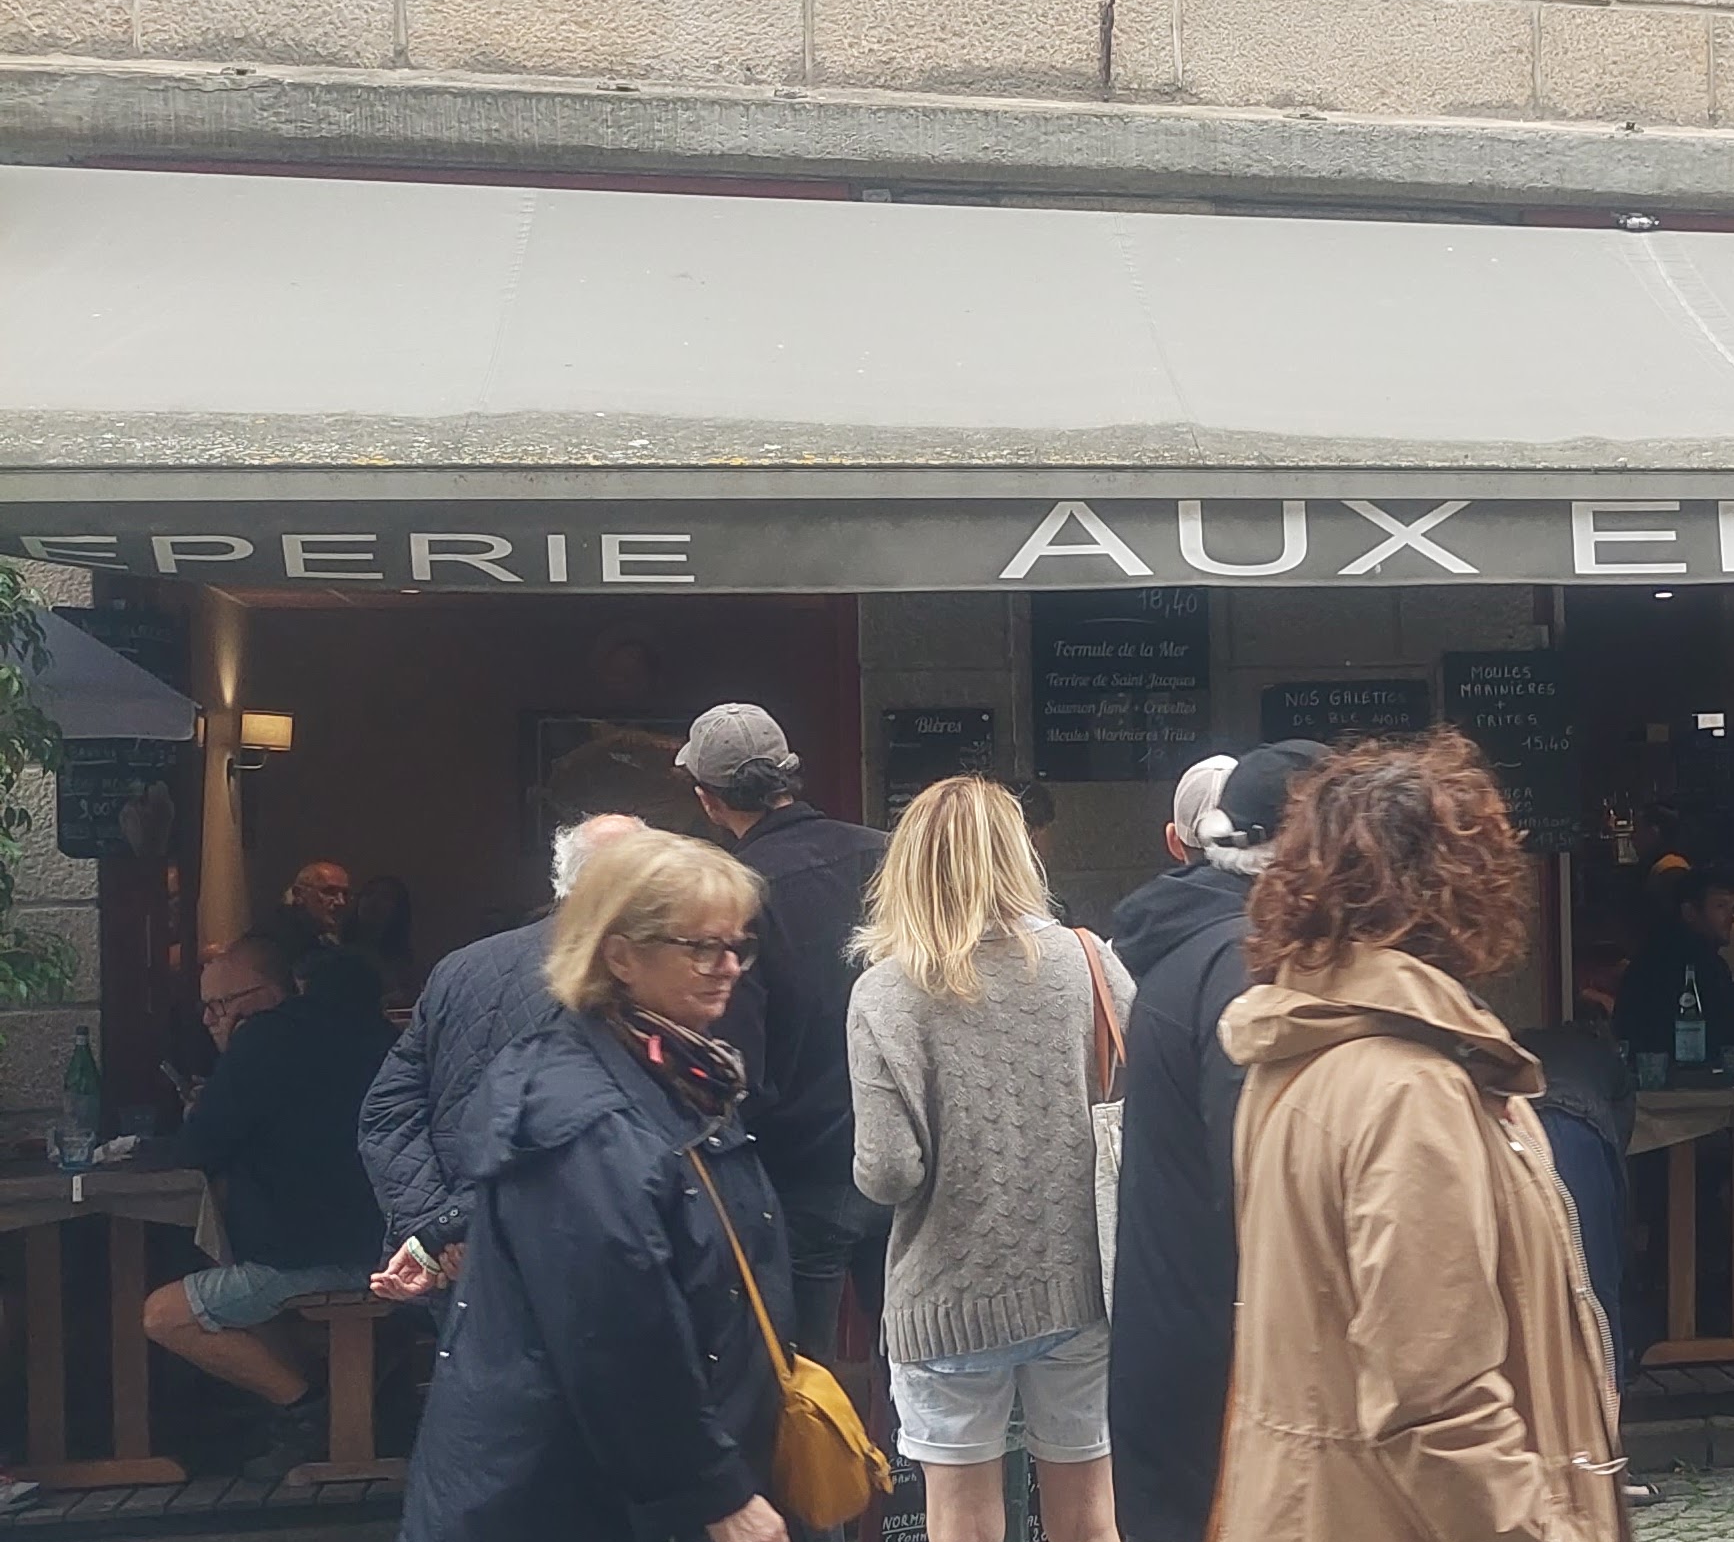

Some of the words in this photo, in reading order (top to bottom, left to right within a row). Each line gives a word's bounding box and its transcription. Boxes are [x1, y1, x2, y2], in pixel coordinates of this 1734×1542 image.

[998, 500, 1480, 580] AUX
[1053, 640, 1115, 658] Formule
[1118, 642, 1136, 658] de
[1139, 642, 1154, 658] la
[1159, 640, 1190, 658] Mer
[1046, 672, 1091, 688] Terrine
[1092, 673, 1107, 687] de
[1470, 666, 1533, 680] MOULES
[1284, 690, 1320, 707] NOS
[1044, 700, 1095, 715] Saumon
[1144, 700, 1197, 715] Crevettes
[1292, 713, 1315, 727] DE
[1476, 713, 1538, 728] FRITES
